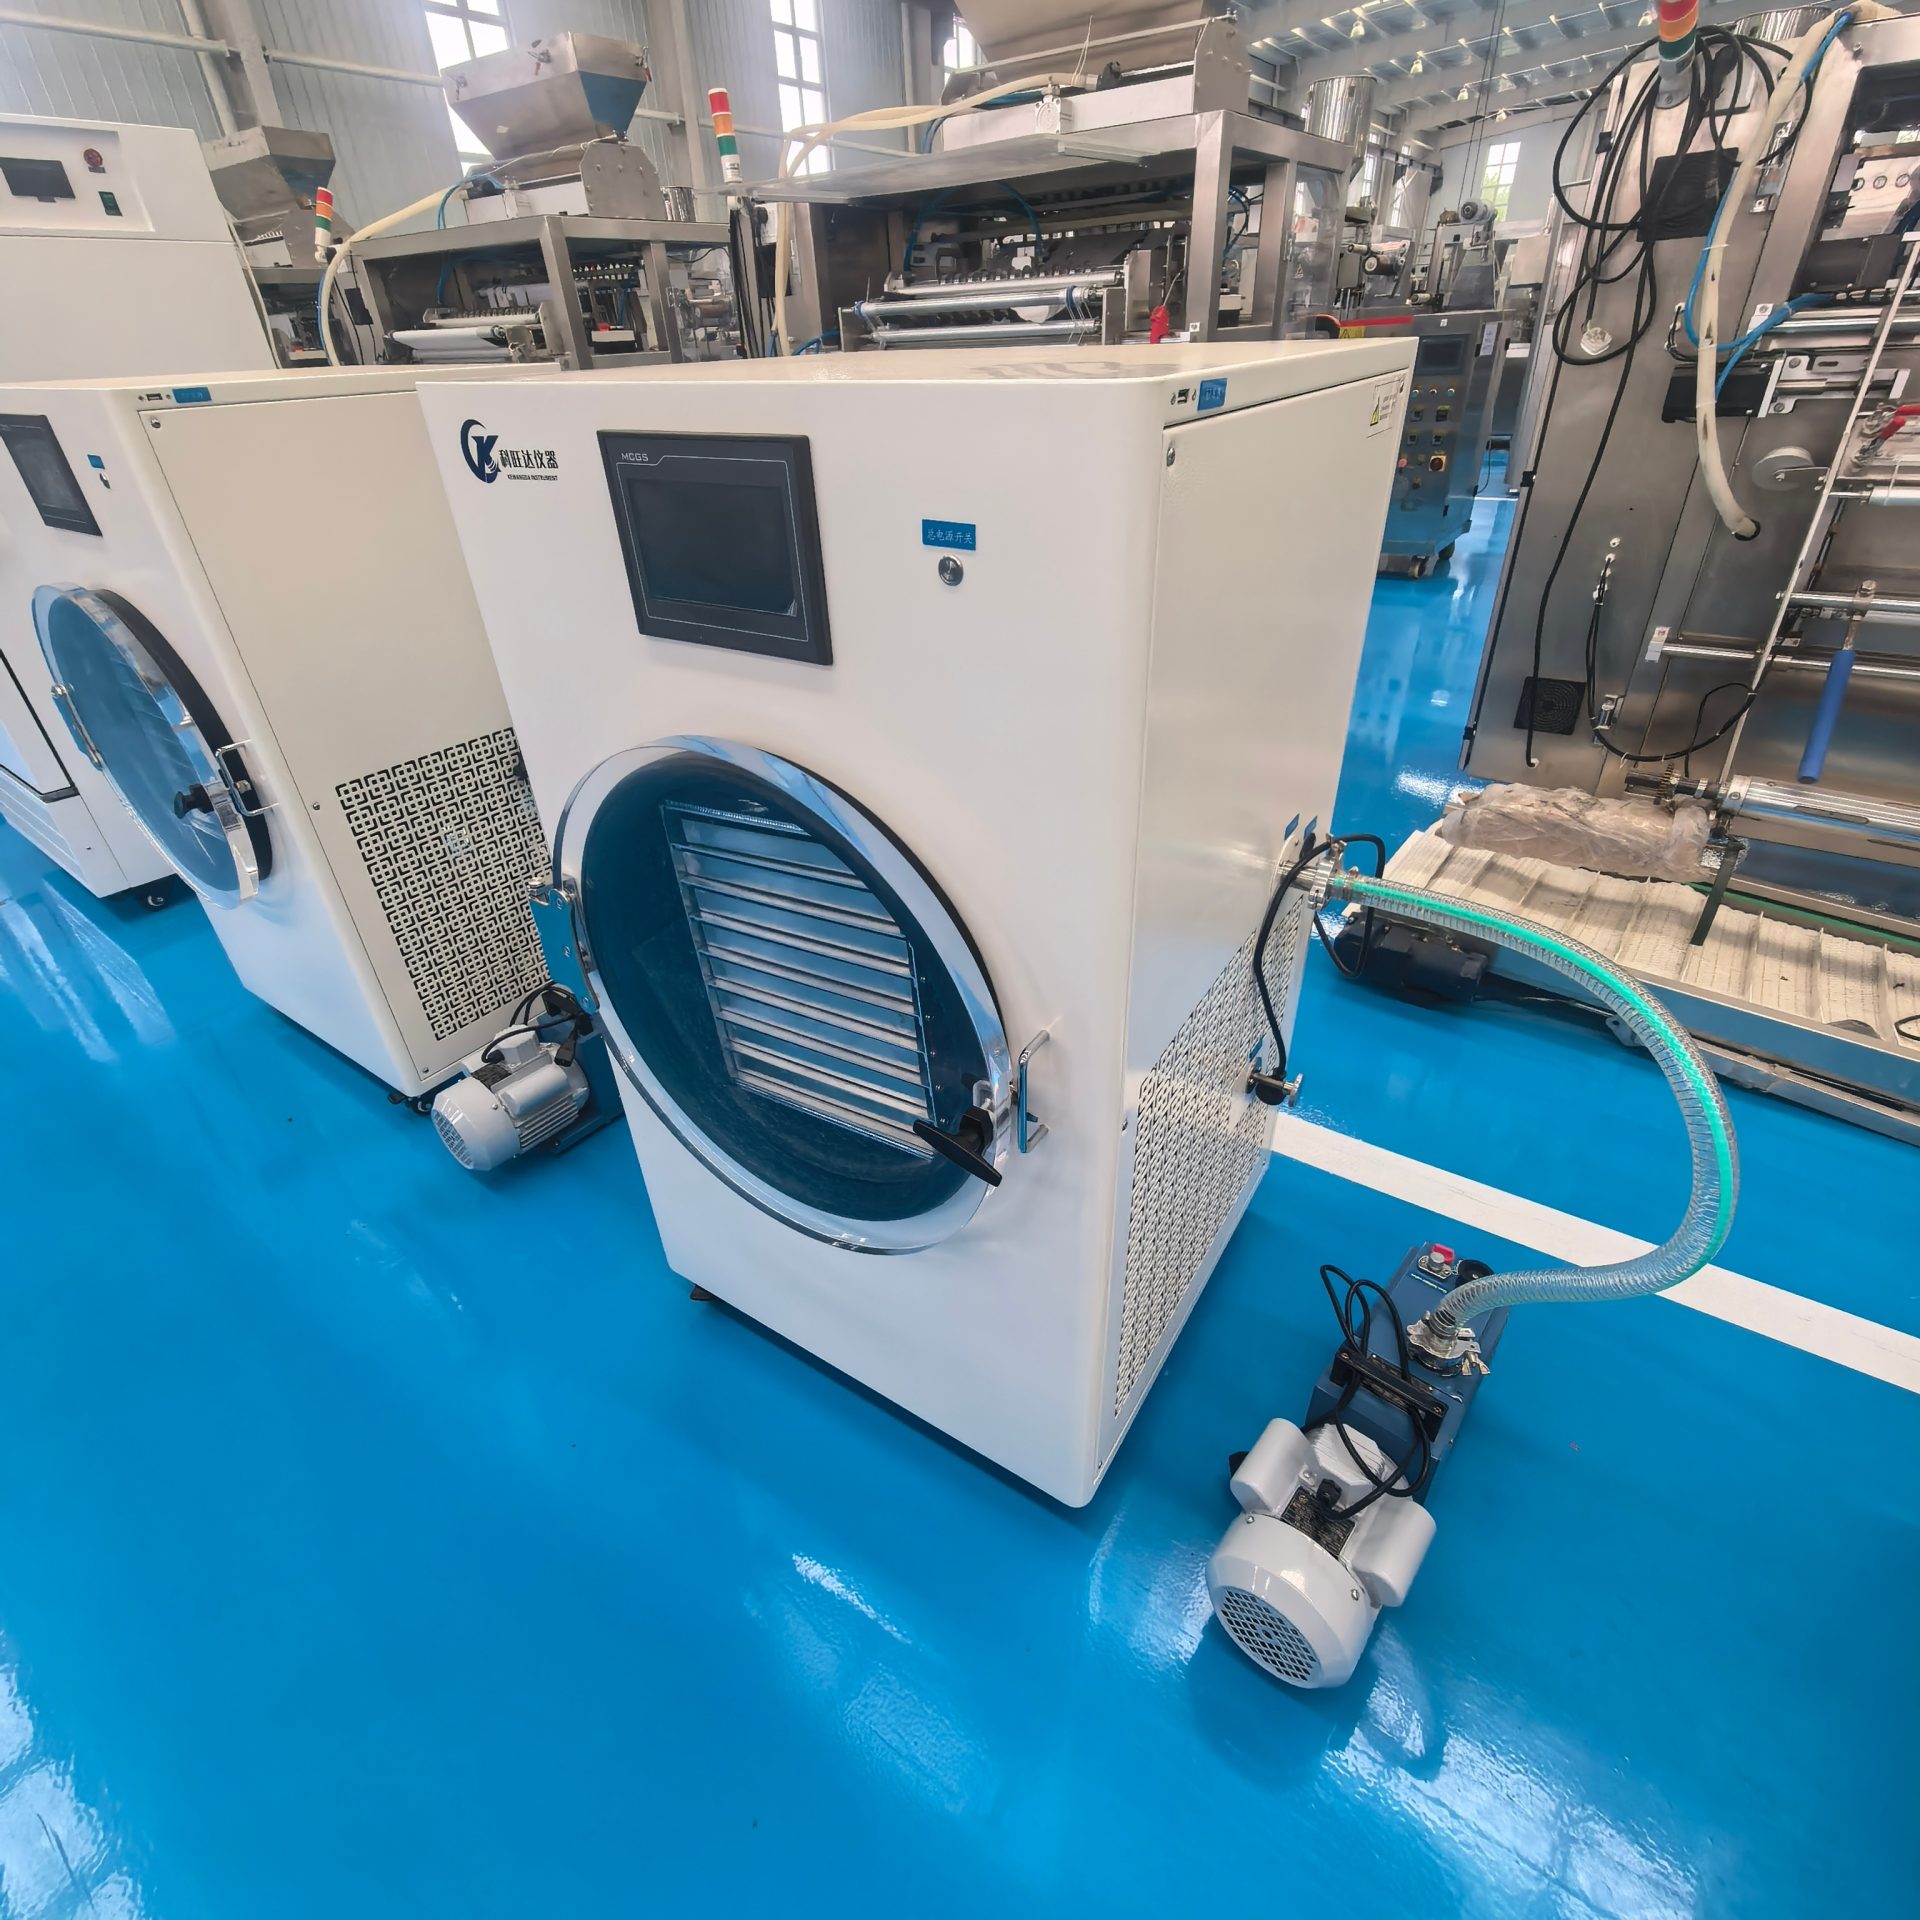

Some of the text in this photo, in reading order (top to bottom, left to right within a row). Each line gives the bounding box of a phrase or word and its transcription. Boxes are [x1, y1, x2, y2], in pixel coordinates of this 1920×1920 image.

[499, 449, 559, 469] 科旺达仪器
[621, 452, 649, 462] MCGS
[927, 528, 973, 545] 总电源开关
